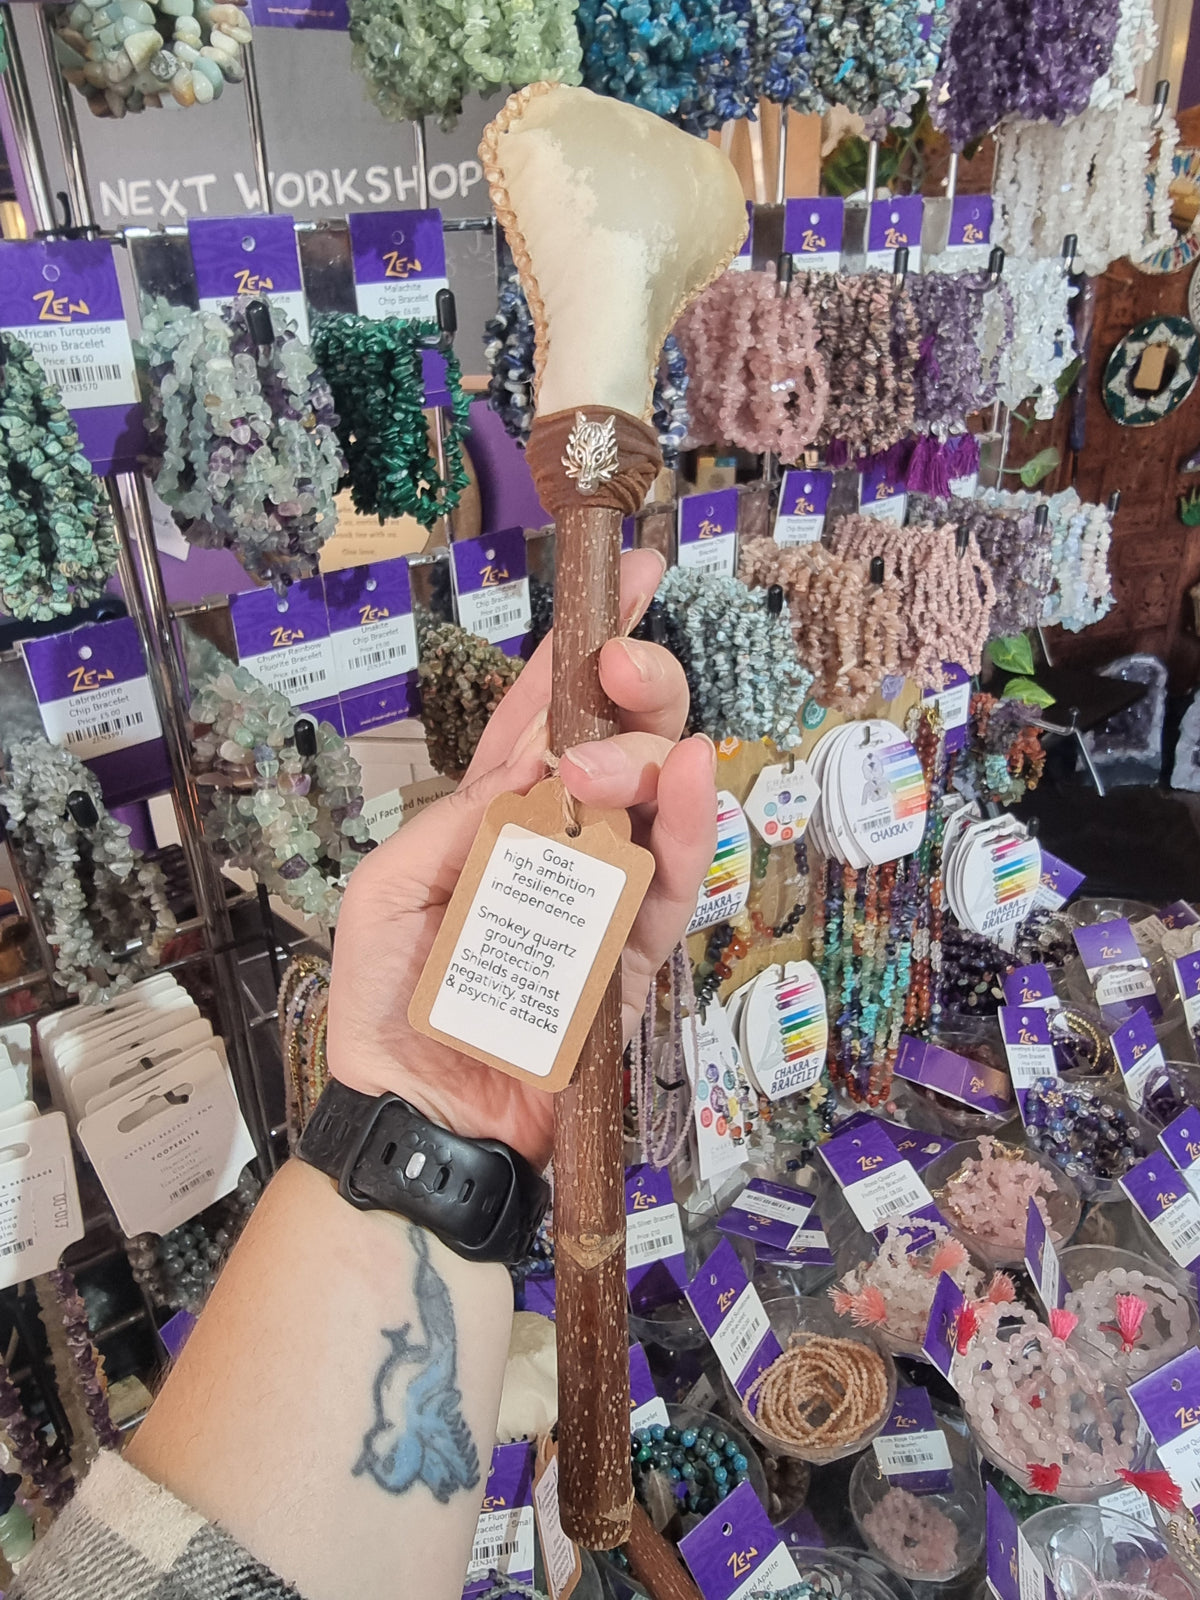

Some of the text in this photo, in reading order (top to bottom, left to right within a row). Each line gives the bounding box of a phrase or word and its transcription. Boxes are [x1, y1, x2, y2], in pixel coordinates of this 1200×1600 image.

[99, 160, 483, 218] NEXT WORKSHOP
[802, 229, 827, 252] ZEN
[382, 251, 423, 278] ZEN
[234, 269, 274, 295] ZEN
[384, 283, 421, 293] Malachite
[33, 289, 90, 322] ZEN
[399, 293, 429, 304] Bracelet
[17, 325, 111, 340] African Turquoise
[32, 339, 105, 354] Chip Bracelet
[70, 355, 94, 364] £5.00
[698, 520, 722, 538] ZEN
[479, 565, 509, 587] ZEN
[359, 604, 389, 624] ZEN
[270, 627, 304, 647] ZEN
[353, 627, 399, 646] Chip Bracelet
[257, 642, 322, 664] Chunky Rainbow
[259, 651, 322, 673] Fluorite Bracelet
[67, 666, 115, 692] ZEN
[69, 687, 123, 708] Labradorite
[69, 695, 130, 718] Chip Bracelet
[380, 799, 415, 820] Faceted
[870, 822, 908, 843] CHAKRA
[542, 848, 574, 872] Goat
[504, 849, 596, 898] high ambition
[512, 871, 575, 906] resilience
[491, 877, 586, 928] independence
[695, 894, 732, 918] CHAKRA
[986, 900, 1020, 920] CHAKRA
[688, 901, 742, 931] BRACELET
[982, 904, 1027, 931] BRACELET
[477, 905, 577, 958] Smokey quartz
[484, 928, 556, 969] grounding,
[1100, 946, 1122, 959] ZEN
[479, 943, 550, 980] protection
[461, 948, 561, 1002] Shields against
[450, 961, 560, 1018] negativity, stress
[1019, 988, 1042, 1002] ZEN
[445, 974, 559, 1034] & psychic attacks
[1018, 1028, 1039, 1045] ZEN
[770, 1066, 819, 1095] BRACELET
[774, 1058, 810, 1081] CHAKRA
[857, 1156, 883, 1171] ZEN
[631, 1191, 657, 1209] ZEN
[1157, 1192, 1177, 1210] ZEN
[488, 1511, 518, 1521] Fluorite
[727, 1547, 758, 1579] ZEN
[757, 1560, 779, 1586] Apatite
